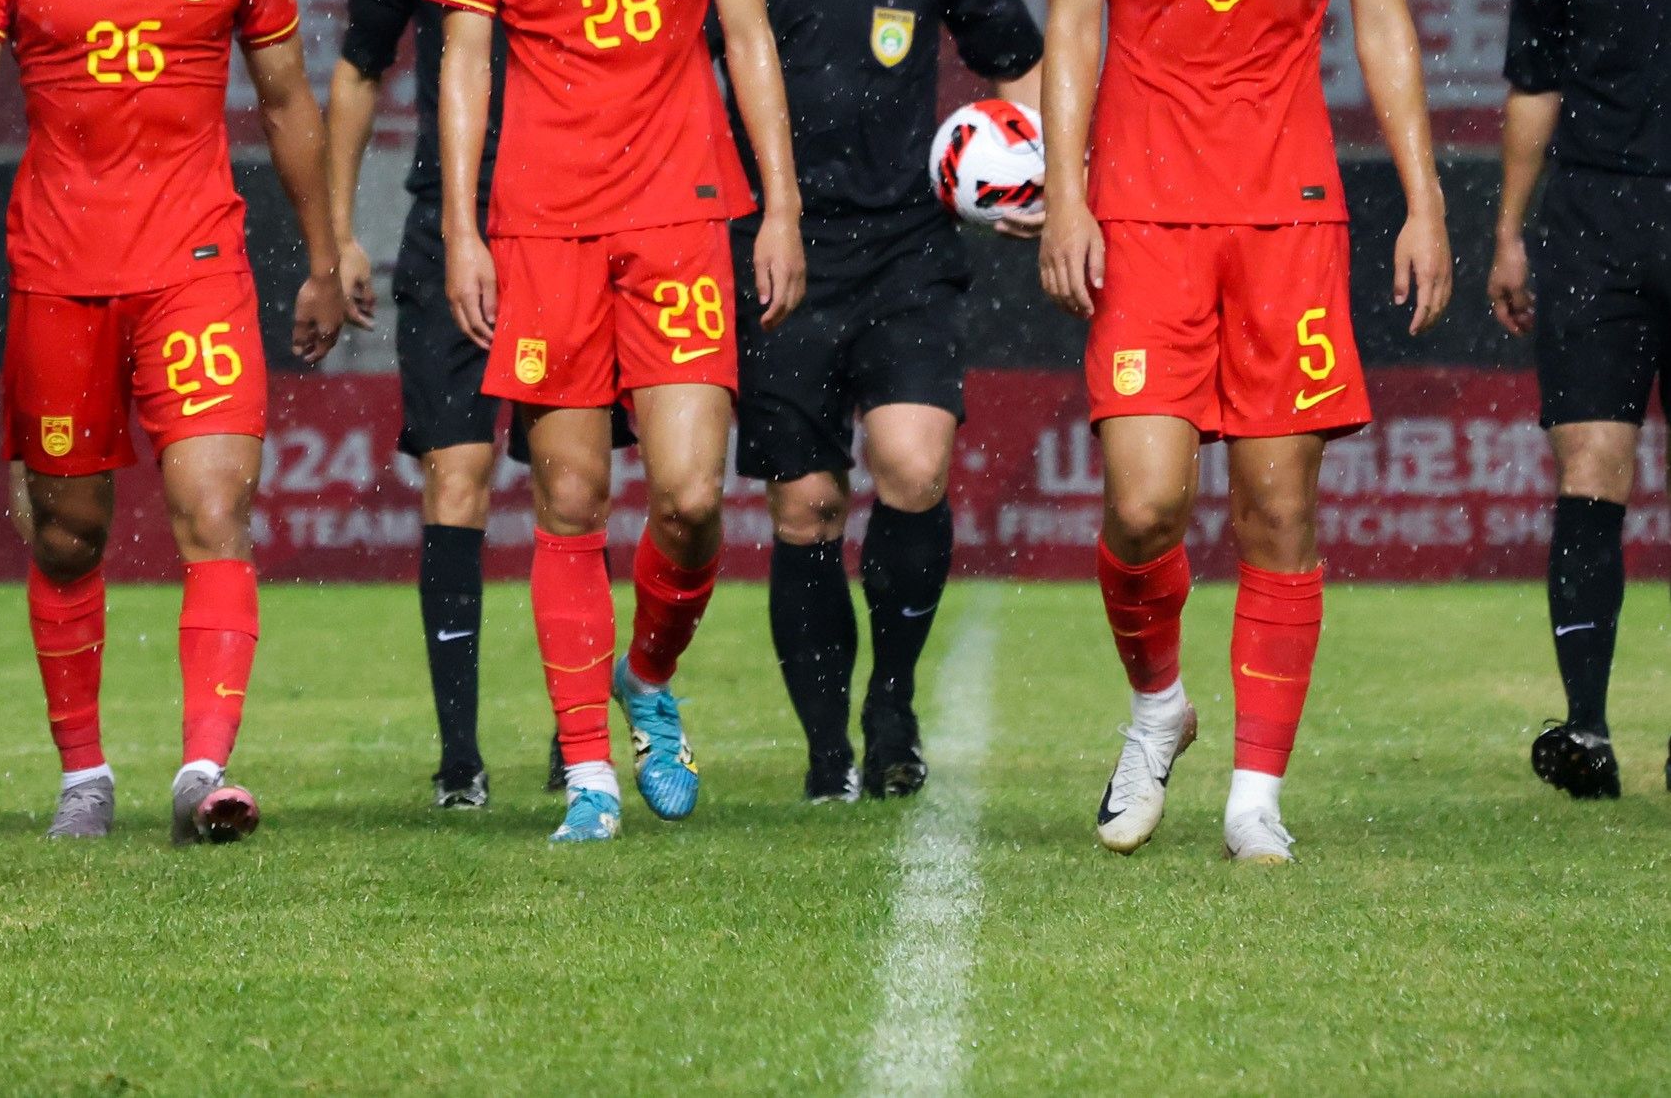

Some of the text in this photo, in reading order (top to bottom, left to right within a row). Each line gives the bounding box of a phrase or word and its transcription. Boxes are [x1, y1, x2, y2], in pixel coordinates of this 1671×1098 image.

[86, 21, 165, 83] 26
[653, 276, 725, 339] 28
[163, 322, 242, 394] 26
[1297, 308, 1336, 380] 5
